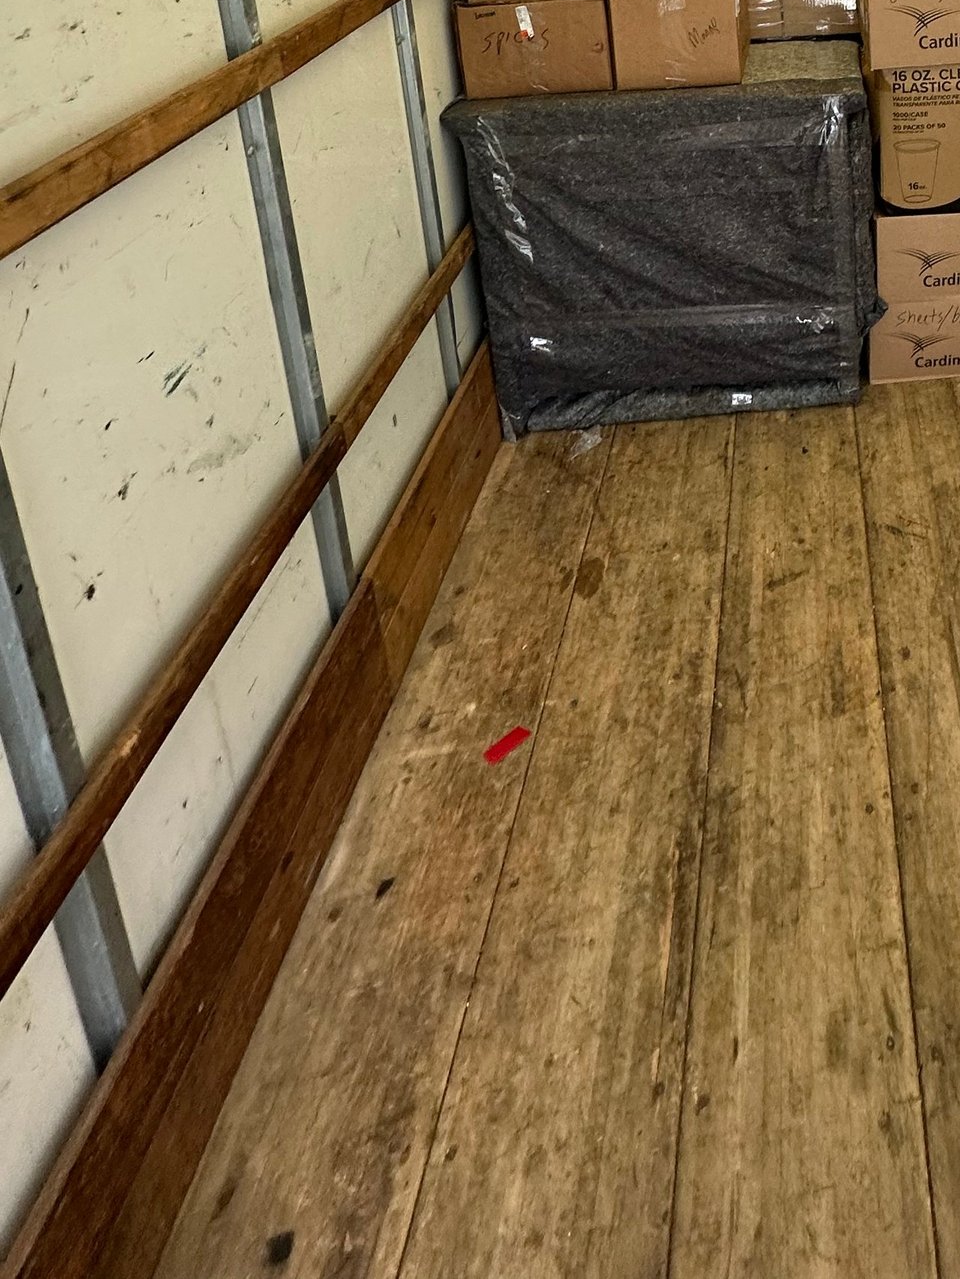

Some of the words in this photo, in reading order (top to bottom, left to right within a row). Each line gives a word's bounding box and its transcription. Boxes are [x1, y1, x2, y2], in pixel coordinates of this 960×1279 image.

[892, 70, 907, 82] 16
[911, 69, 935, 81] OZ.
[892, 80, 951, 94] PLASTIC
[893, 124, 902, 132] 20
[908, 182, 919, 191] 16
